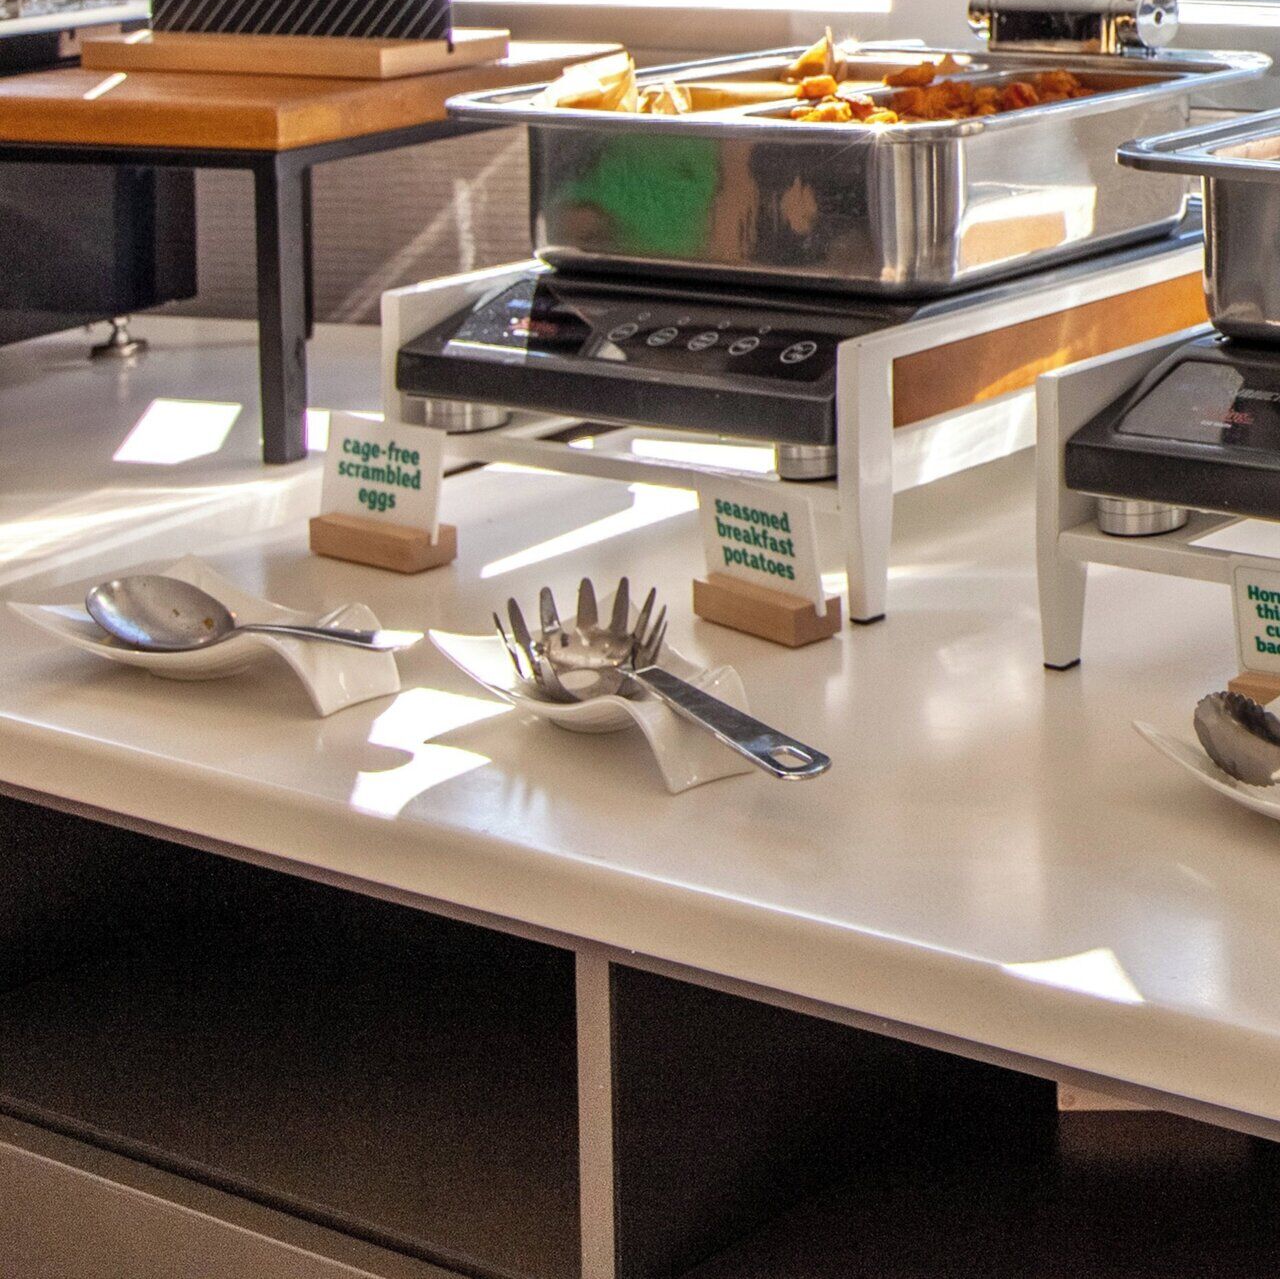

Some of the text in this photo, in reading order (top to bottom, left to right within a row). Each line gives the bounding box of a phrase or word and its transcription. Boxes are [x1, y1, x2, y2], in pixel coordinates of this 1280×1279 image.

[342, 437, 420, 466] cage-free
[338, 460, 421, 490] scrambled
[358, 487, 396, 512] eggs
[715, 498, 791, 533] seasoned
[715, 515, 796, 557] breakfast
[722, 545, 796, 581] potatoes
